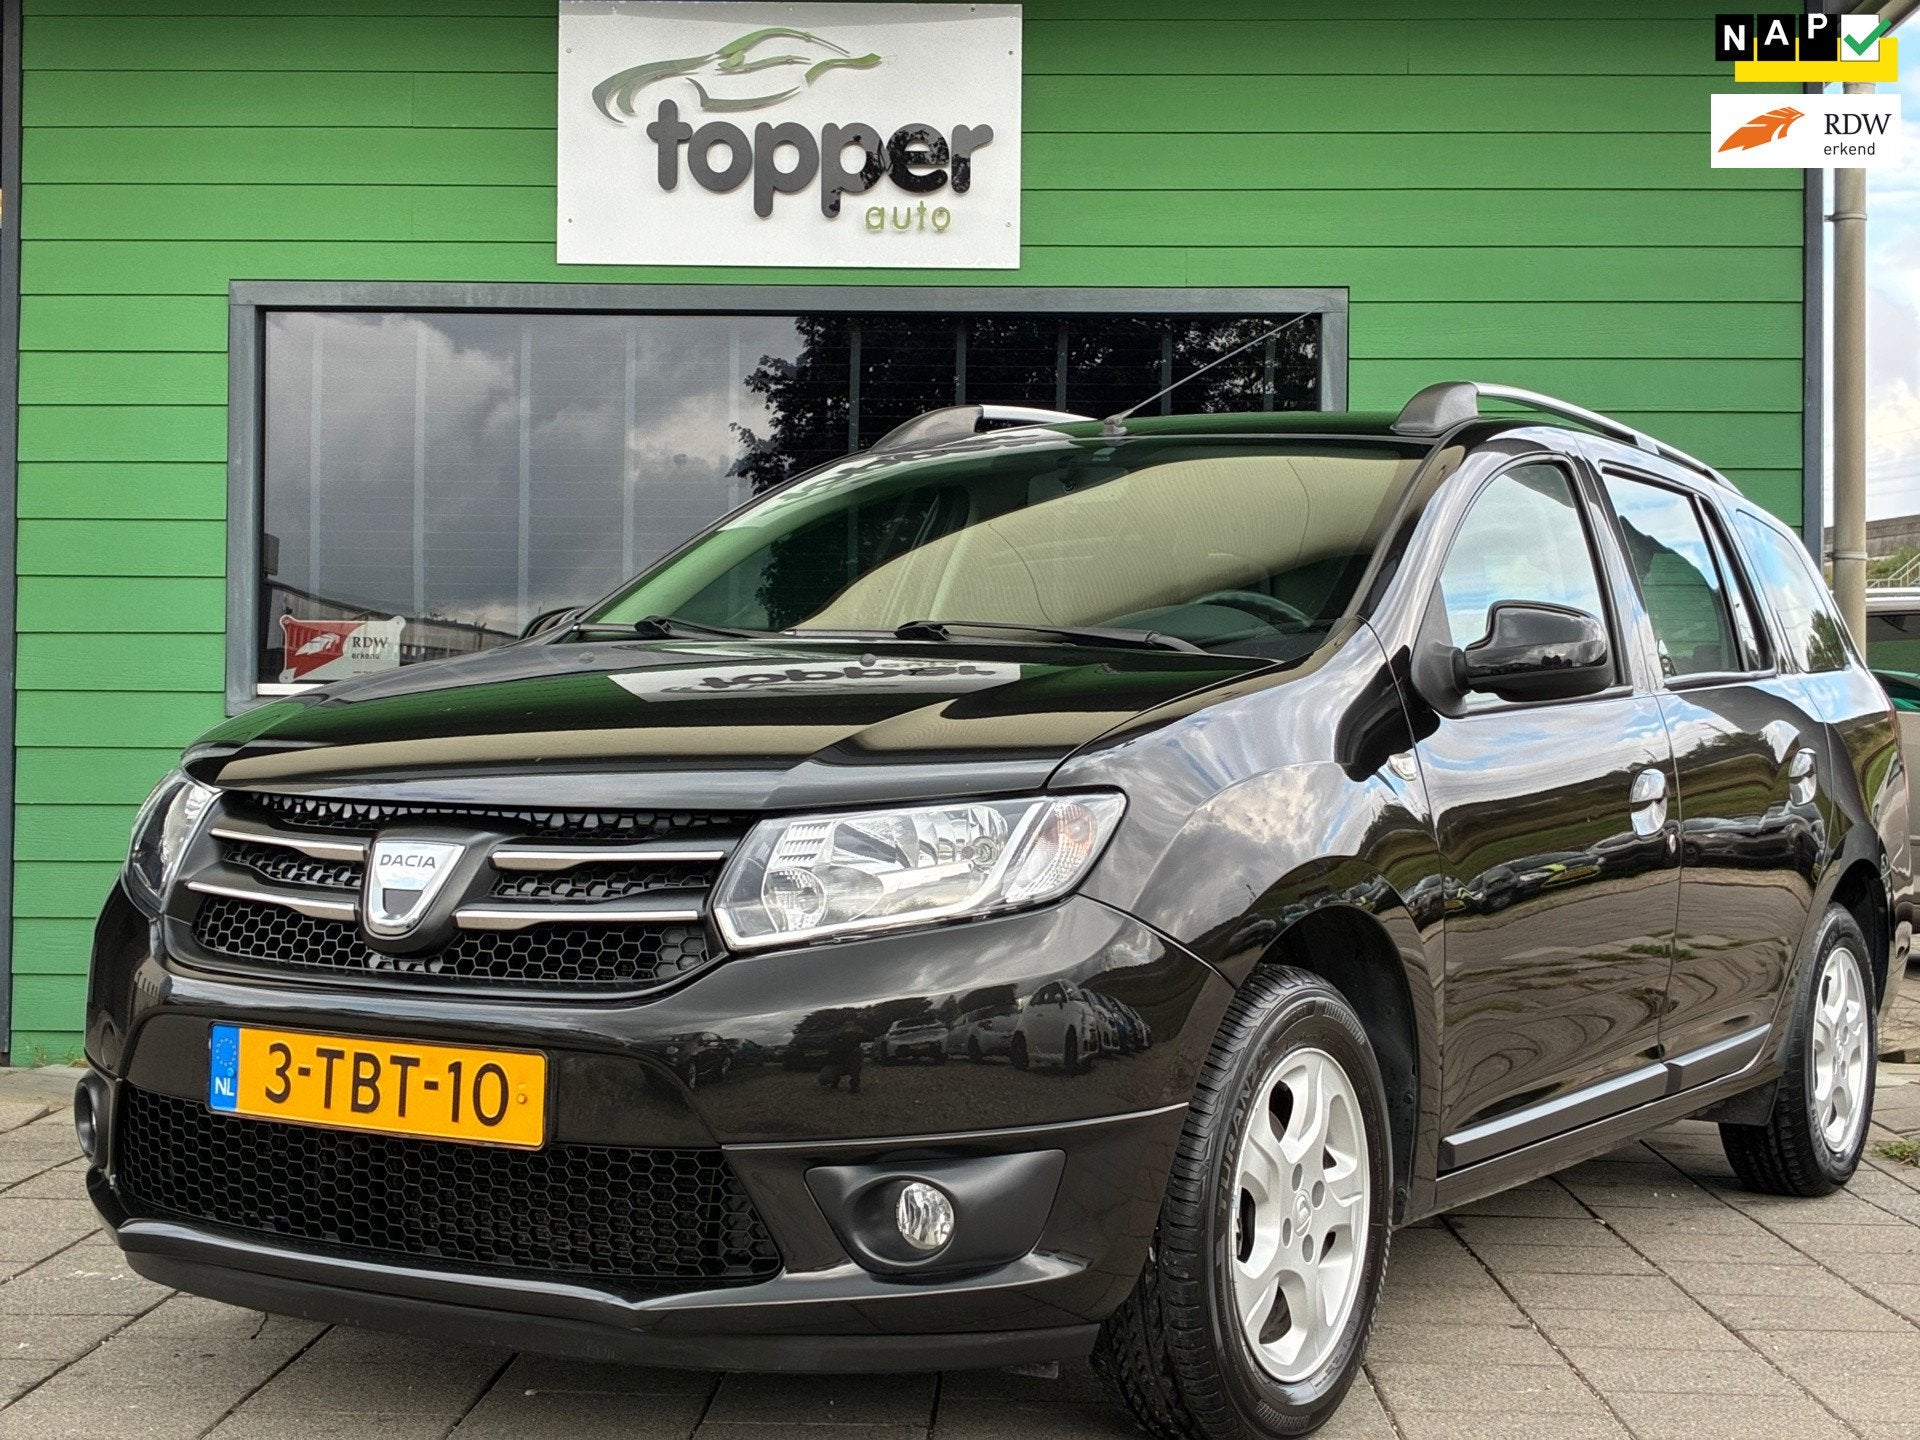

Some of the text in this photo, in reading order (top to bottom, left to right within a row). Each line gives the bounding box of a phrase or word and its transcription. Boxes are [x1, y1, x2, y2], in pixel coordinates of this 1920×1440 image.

[646, 99, 994, 218] topper
[865, 200, 951, 231] auto
[352, 636, 388, 648] RDW
[380, 854, 436, 869] DACIA
[215, 1042, 510, 1127] NL 3-TBT-10
